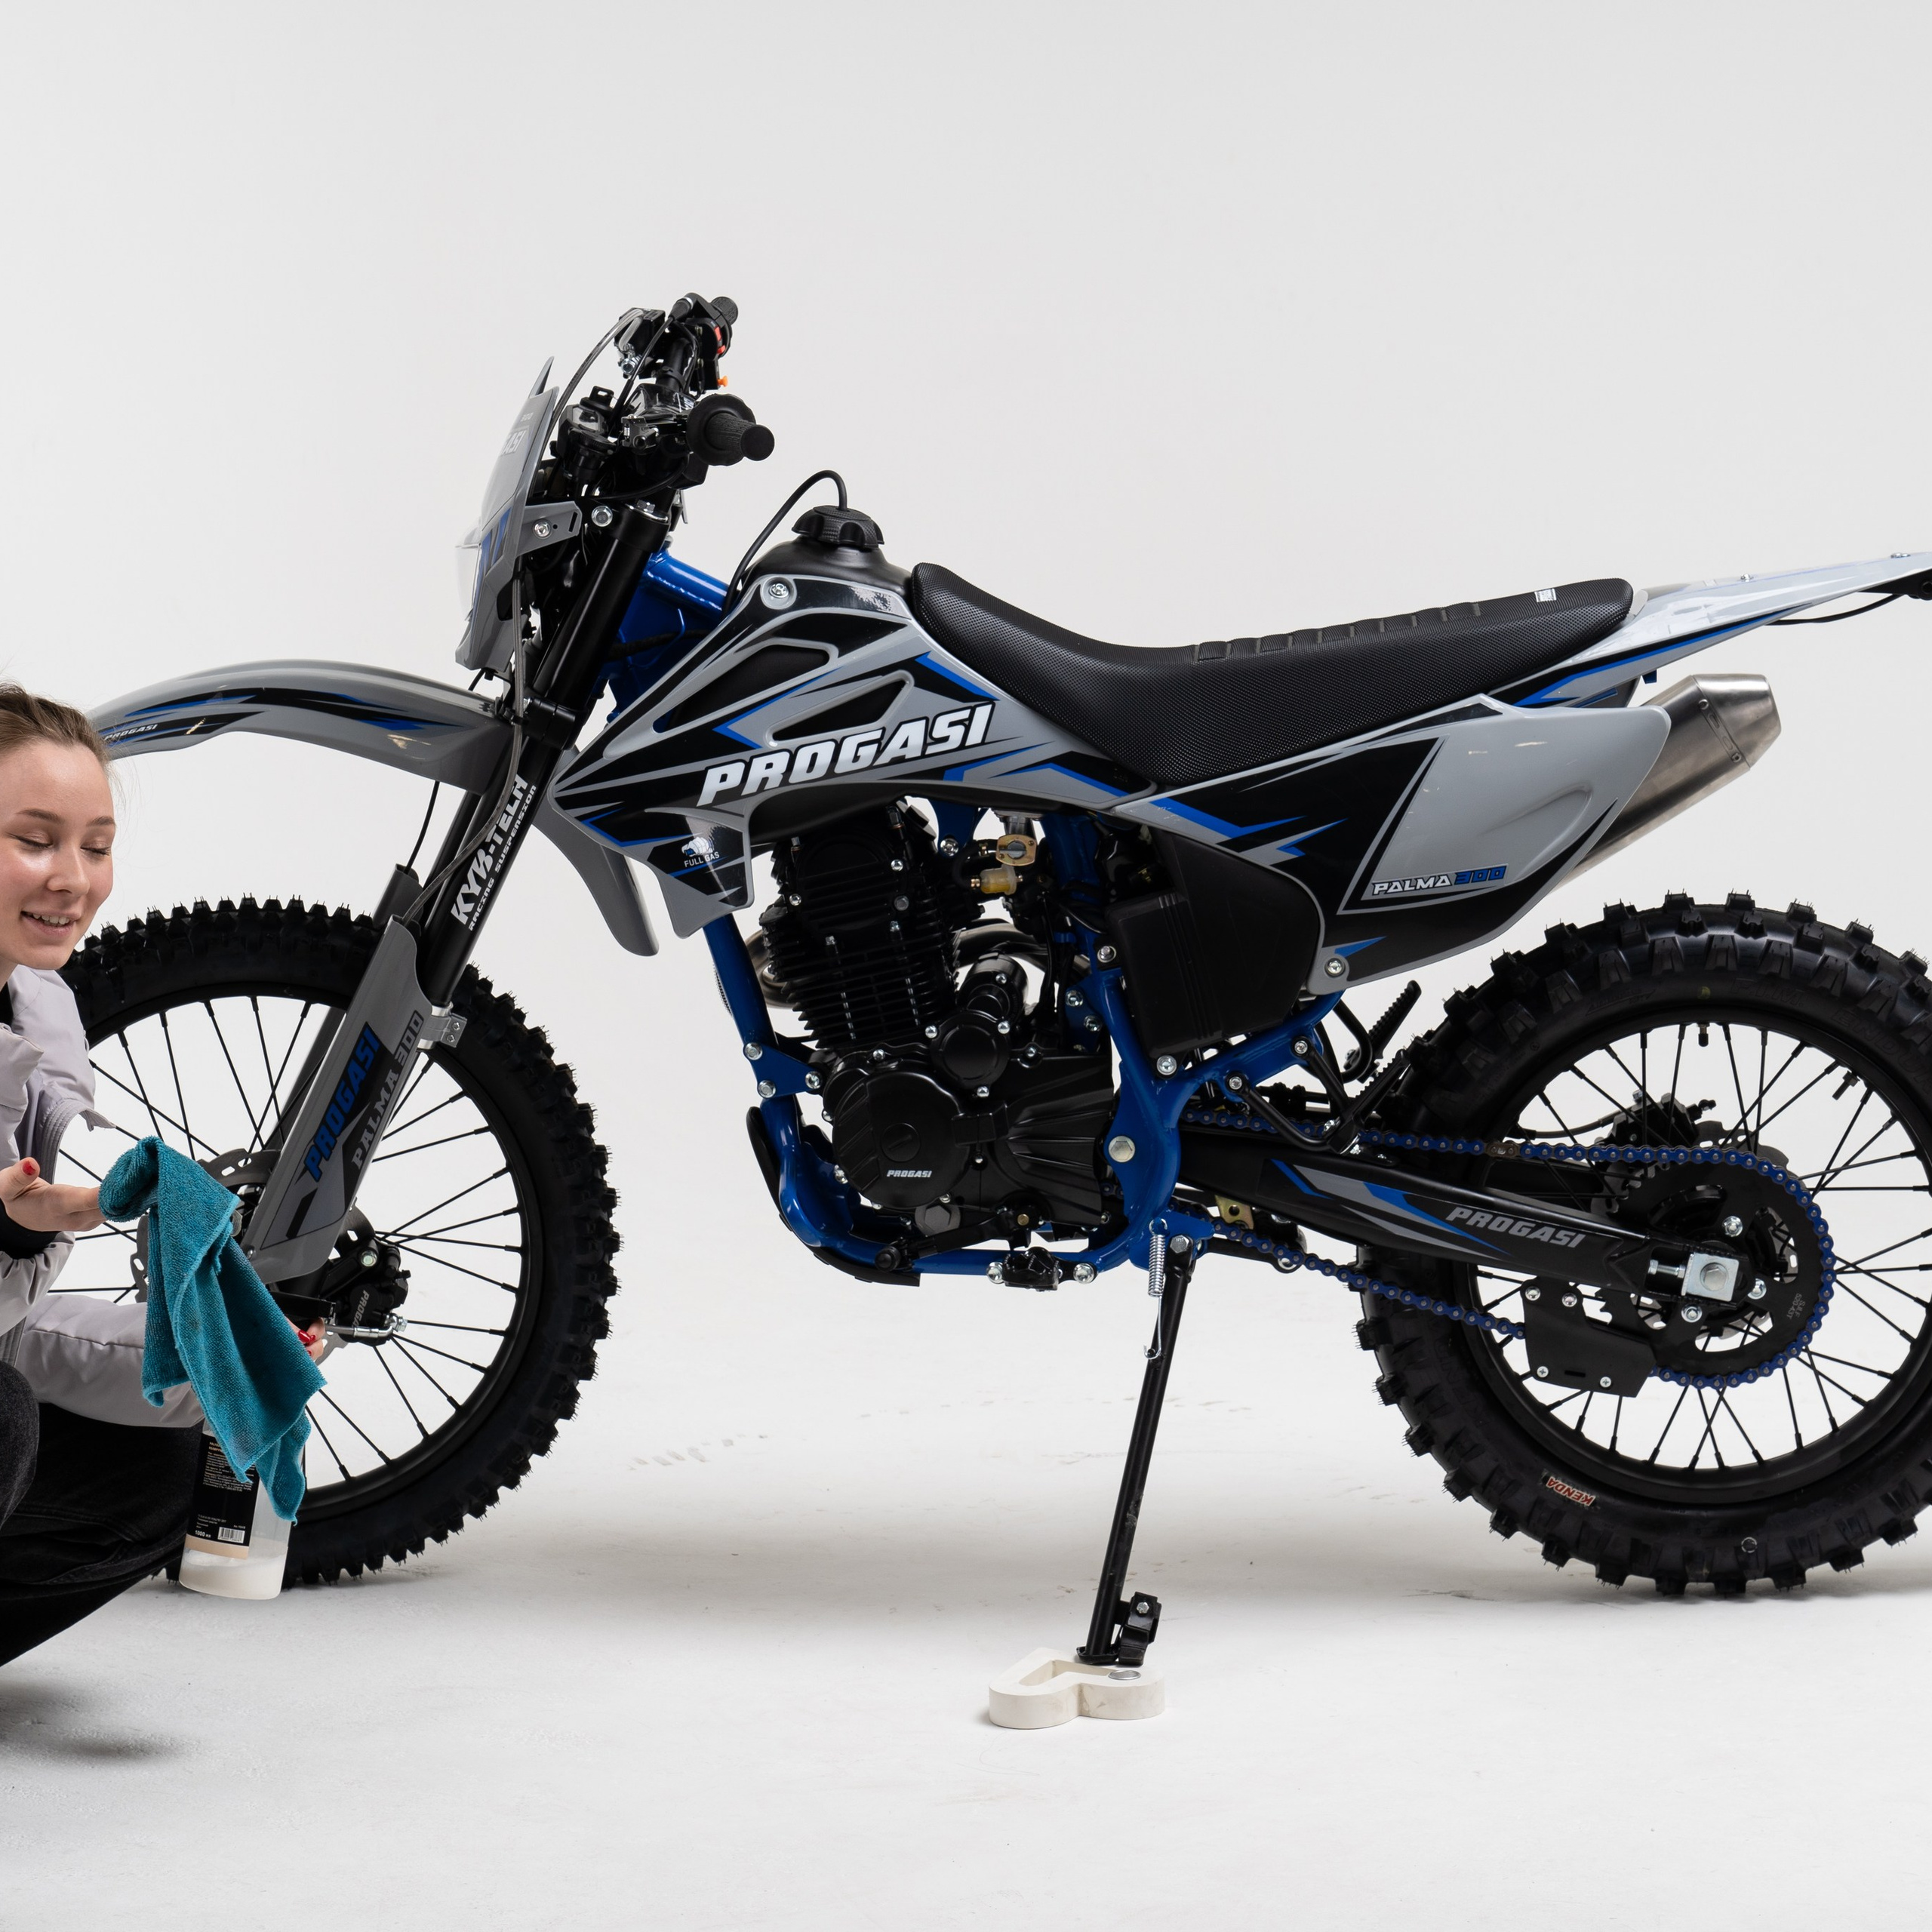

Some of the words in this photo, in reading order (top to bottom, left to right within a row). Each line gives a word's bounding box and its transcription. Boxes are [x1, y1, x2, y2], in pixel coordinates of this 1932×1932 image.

[104, 724, 158, 740] PROGASI
[697, 703, 993, 807] PROGASI
[468, 878, 495, 931] RACING
[494, 784, 537, 873] SUSPENSION
[684, 857, 704, 867] FULL
[705, 851, 720, 862] GAS
[1372, 874, 1452, 896] PALMA
[1454, 866, 1507, 885] 300
[303, 1024, 381, 1182] PROGASI
[351, 1069, 399, 1170] PALMA
[395, 1011, 424, 1066] 300
[887, 1170, 933, 1178] PROGASI
[1445, 1207, 1586, 1248] PROGASI
[351, 1290, 370, 1327] PROGA
[1546, 1476, 1596, 1506] KENDA
